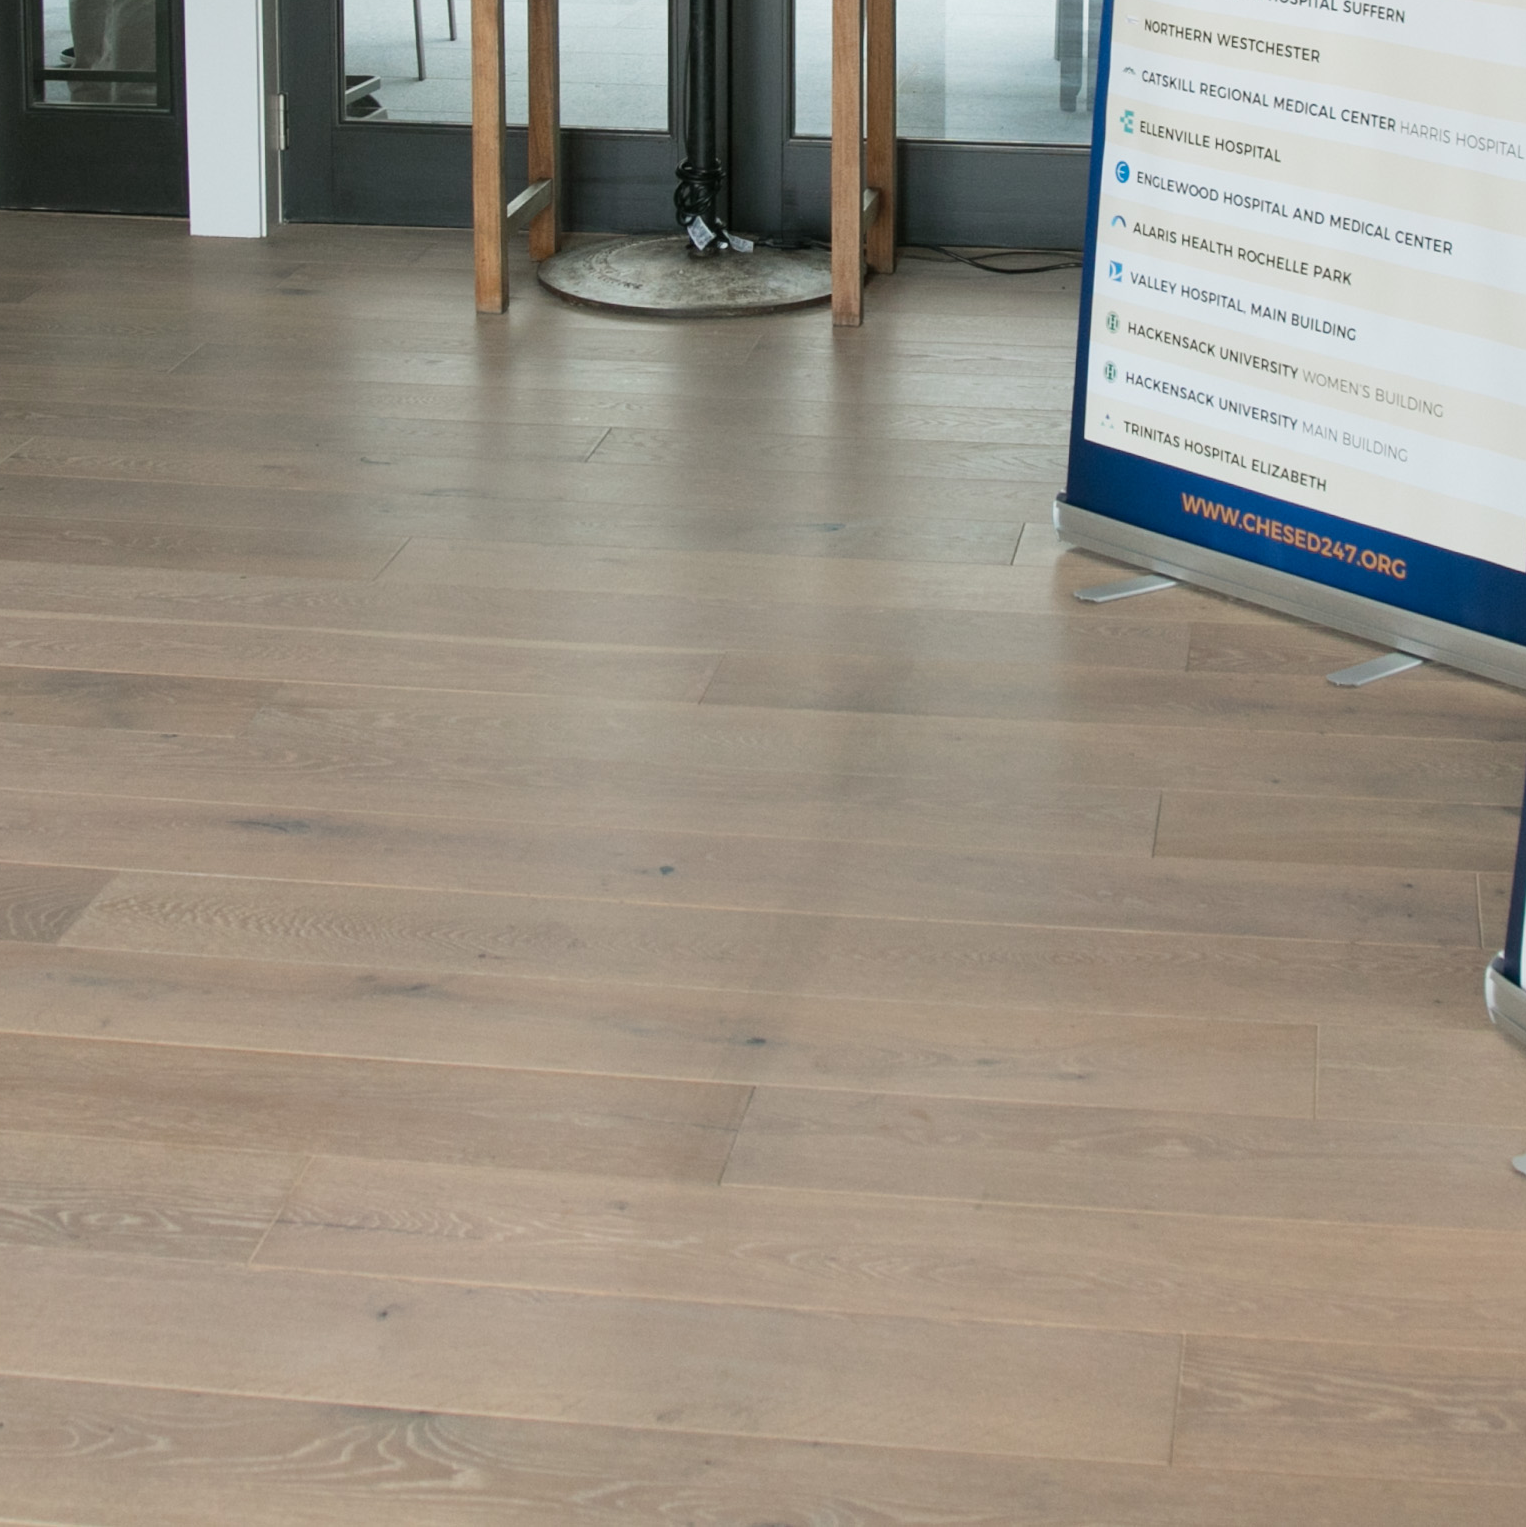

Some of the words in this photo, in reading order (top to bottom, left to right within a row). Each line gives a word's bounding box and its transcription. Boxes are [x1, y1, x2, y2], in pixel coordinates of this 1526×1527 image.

[1144, 19, 1212, 44] NORTHERN
[1217, 33, 1320, 63] WESTCHESTER
[1343, 0, 1405, 23] SUFFERN
[1140, 120, 1210, 148] ELLENVILLE
[1215, 138, 1281, 163] HOSPITAL
[1142, 70, 1195, 93] CATSKILL
[1200, 82, 1269, 107] REGIONAL
[1274, 96, 1336, 120] MEDICAL
[1341, 109, 1396, 131] CENTER
[1400, 121, 1451, 144] HARRIS
[1456, 132, 1524, 160] HOSPITAL
[1137, 171, 1219, 201] ENGLEWOOD
[1223, 192, 1288, 218] HOSPITAL
[1293, 208, 1325, 225] AND
[1330, 214, 1390, 241] MEDICAL
[1395, 230, 1452, 255] CENTER
[1133, 222, 1177, 244] ALARIS
[1181, 234, 1233, 257] HEALTH
[1238, 247, 1308, 276] ROCHELLE
[1313, 265, 1351, 285] PARK
[1130, 272, 1177, 294] VALLEY
[1251, 303, 1286, 323] MAIN
[1291, 313, 1356, 341] BUILDING
[1128, 322, 1215, 357] HACKENSACK
[1220, 347, 1298, 379] UNIVERSITY
[1302, 369, 1370, 399] WOMEN'S
[1375, 388, 1443, 418] BUILDING
[1126, 371, 1214, 407] HACKENSACK
[1219, 397, 1298, 430] UNIVERSITY
[1302, 421, 1338, 442] MAIN
[1342, 431, 1408, 462] BUILDING
[1124, 421, 1180, 448] TRINITAS
[1184, 439, 1247, 469] HOSPITAL
[1251, 459, 1326, 491] ELIZABETH
[1182, 493, 1406, 579] WWW.CHESED247.ORG
